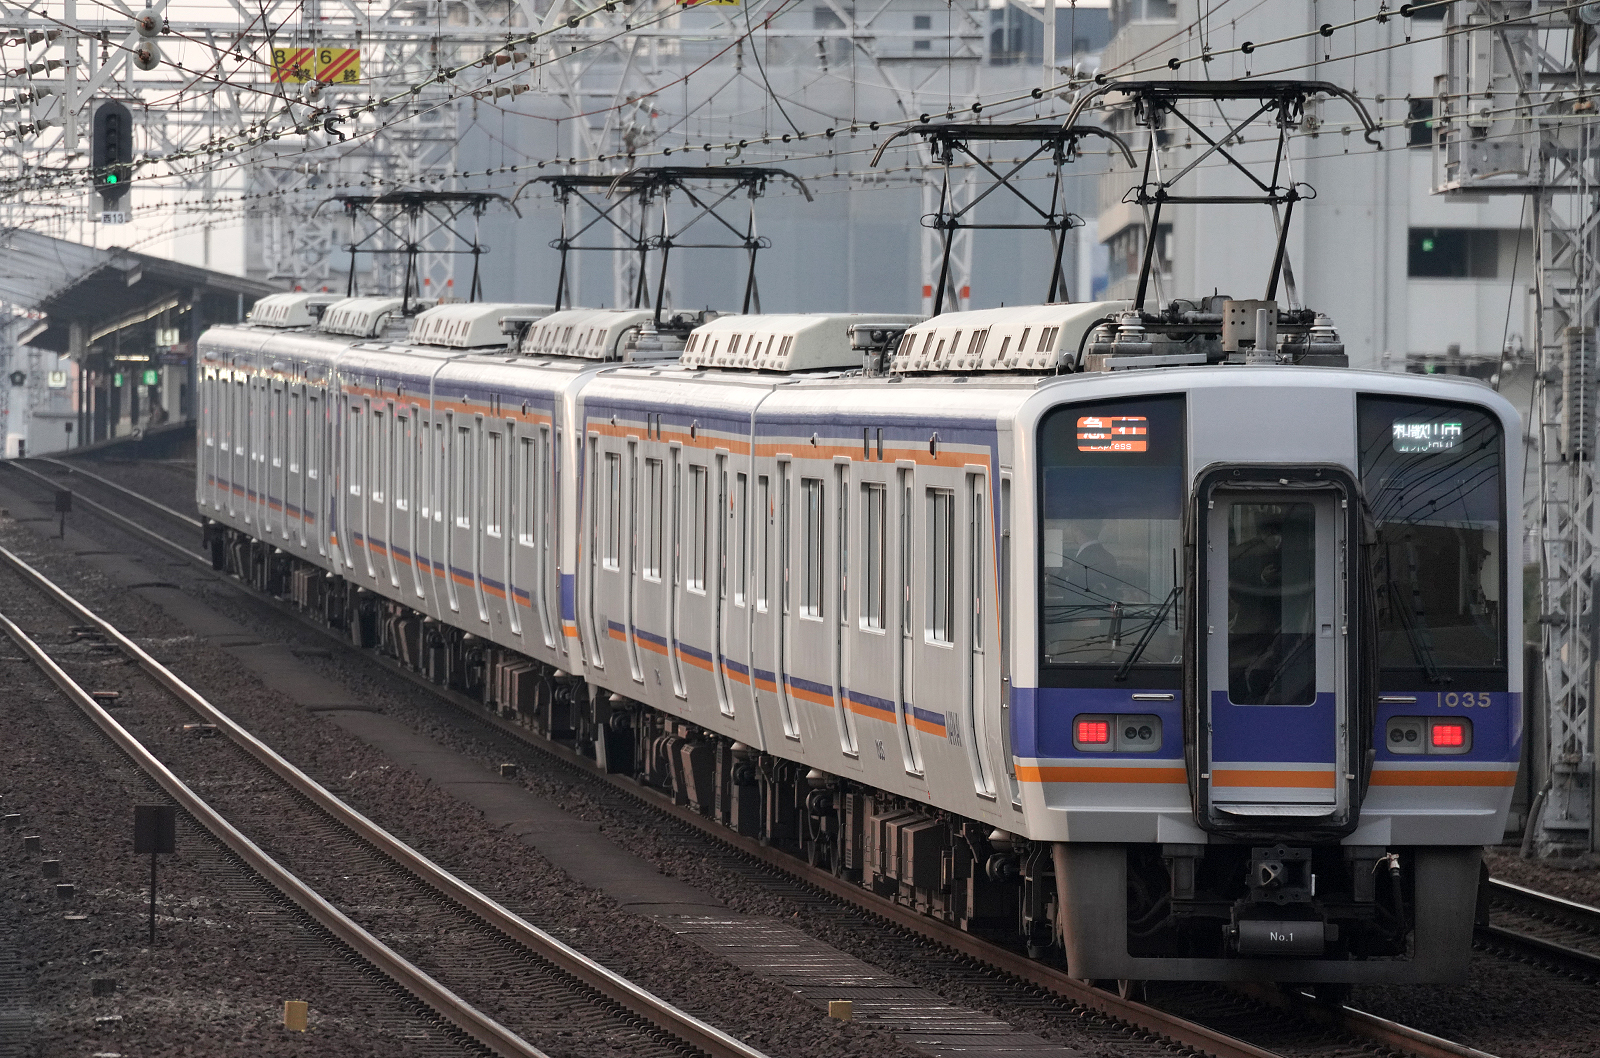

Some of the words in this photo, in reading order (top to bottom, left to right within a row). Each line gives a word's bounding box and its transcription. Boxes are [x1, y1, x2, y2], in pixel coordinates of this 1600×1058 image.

[275, 49, 286, 64] 8
[320, 50, 332, 64] 6
[1437, 692, 1491, 708] 1035
[1270, 931, 1293, 942] No.1
